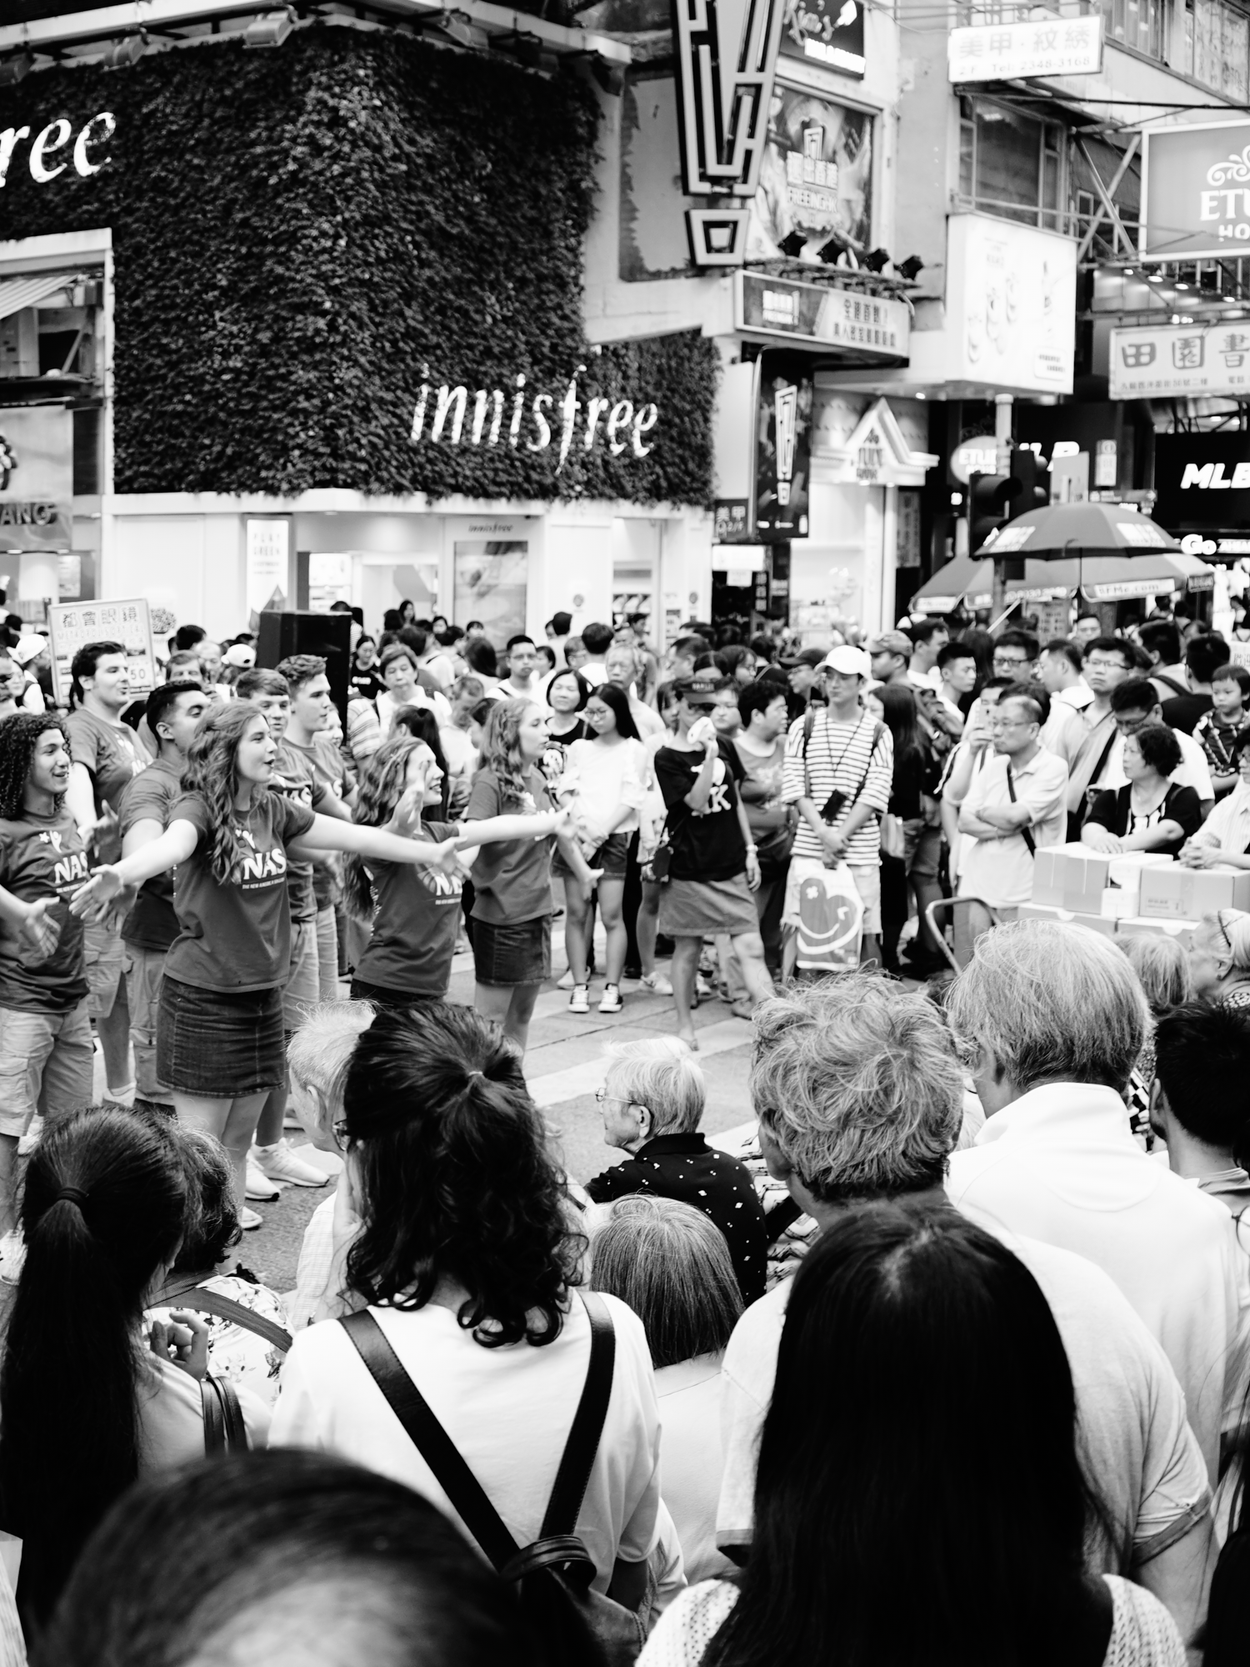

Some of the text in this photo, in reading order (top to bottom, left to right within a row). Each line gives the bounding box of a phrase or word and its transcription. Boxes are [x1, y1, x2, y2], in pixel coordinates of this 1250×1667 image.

[1200, 188, 1250, 221] ET
[410, 363, 658, 475] innisfree
[468, 521, 513, 534] innisfree
[1181, 533, 1217, 555] Go
[243, 848, 287, 880] NAS
